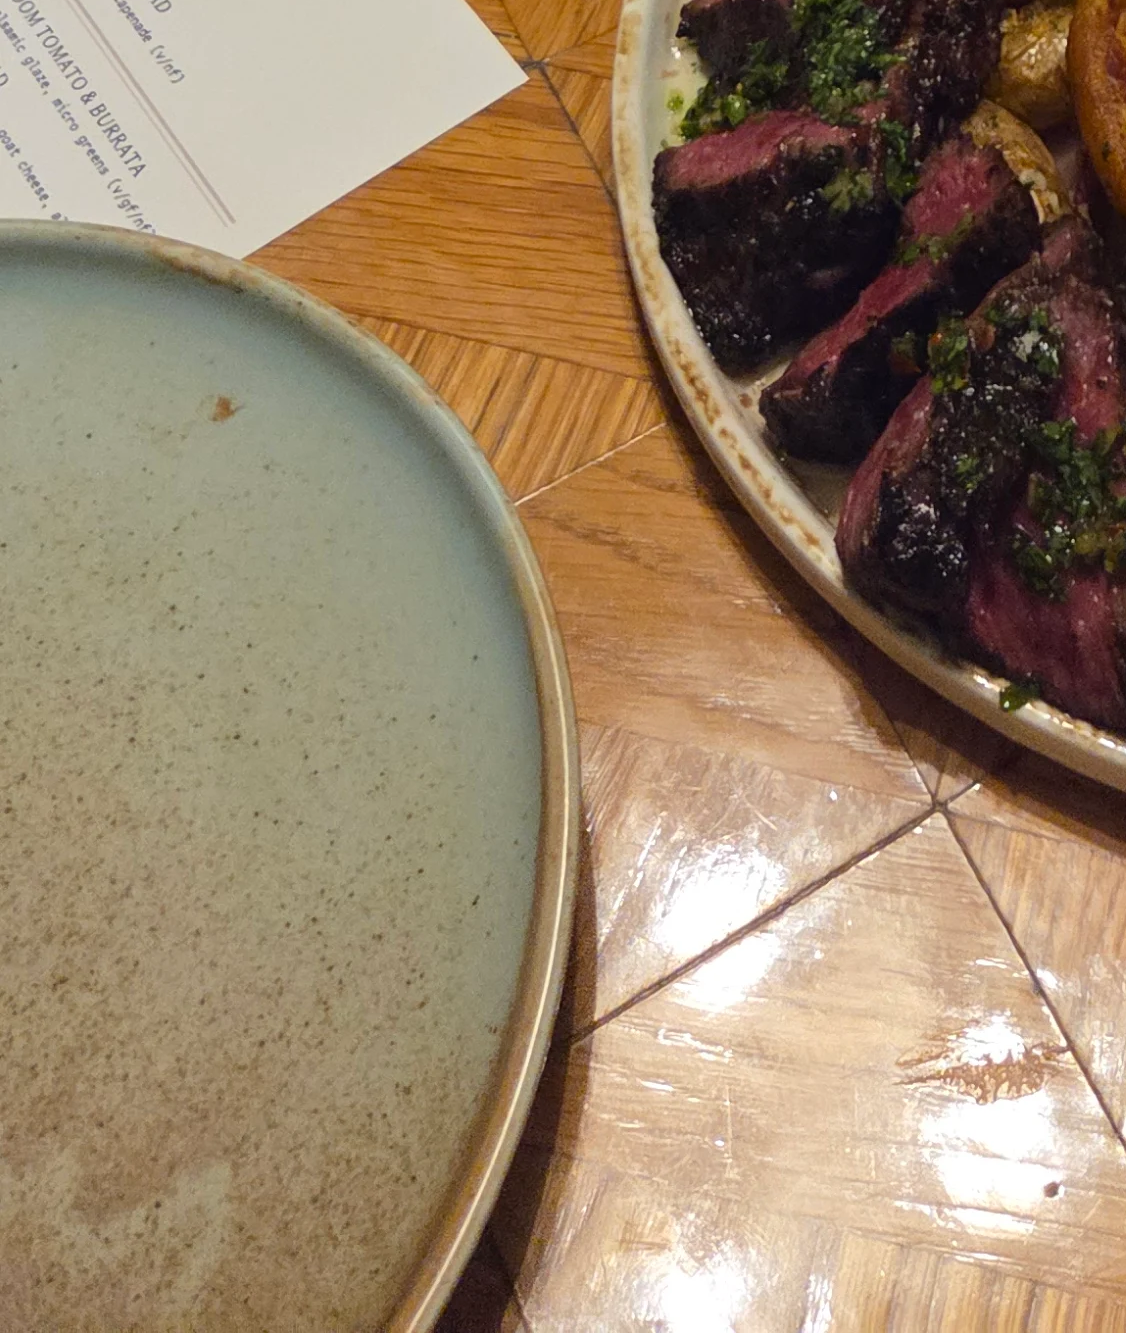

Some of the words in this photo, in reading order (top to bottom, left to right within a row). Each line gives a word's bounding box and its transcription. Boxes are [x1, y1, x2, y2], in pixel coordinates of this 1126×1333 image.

[36, 24, 88, 91] TOMATO
[80, 90, 97, 105] &
[89, 103, 146, 178] BURRATA
[150, 44, 185, 84] (v/nf)
[20, 55, 50, 96] glaze,
[52, 98, 79, 132] micro
[74, 135, 109, 176] greens
[18, 160, 49, 210] cheese,
